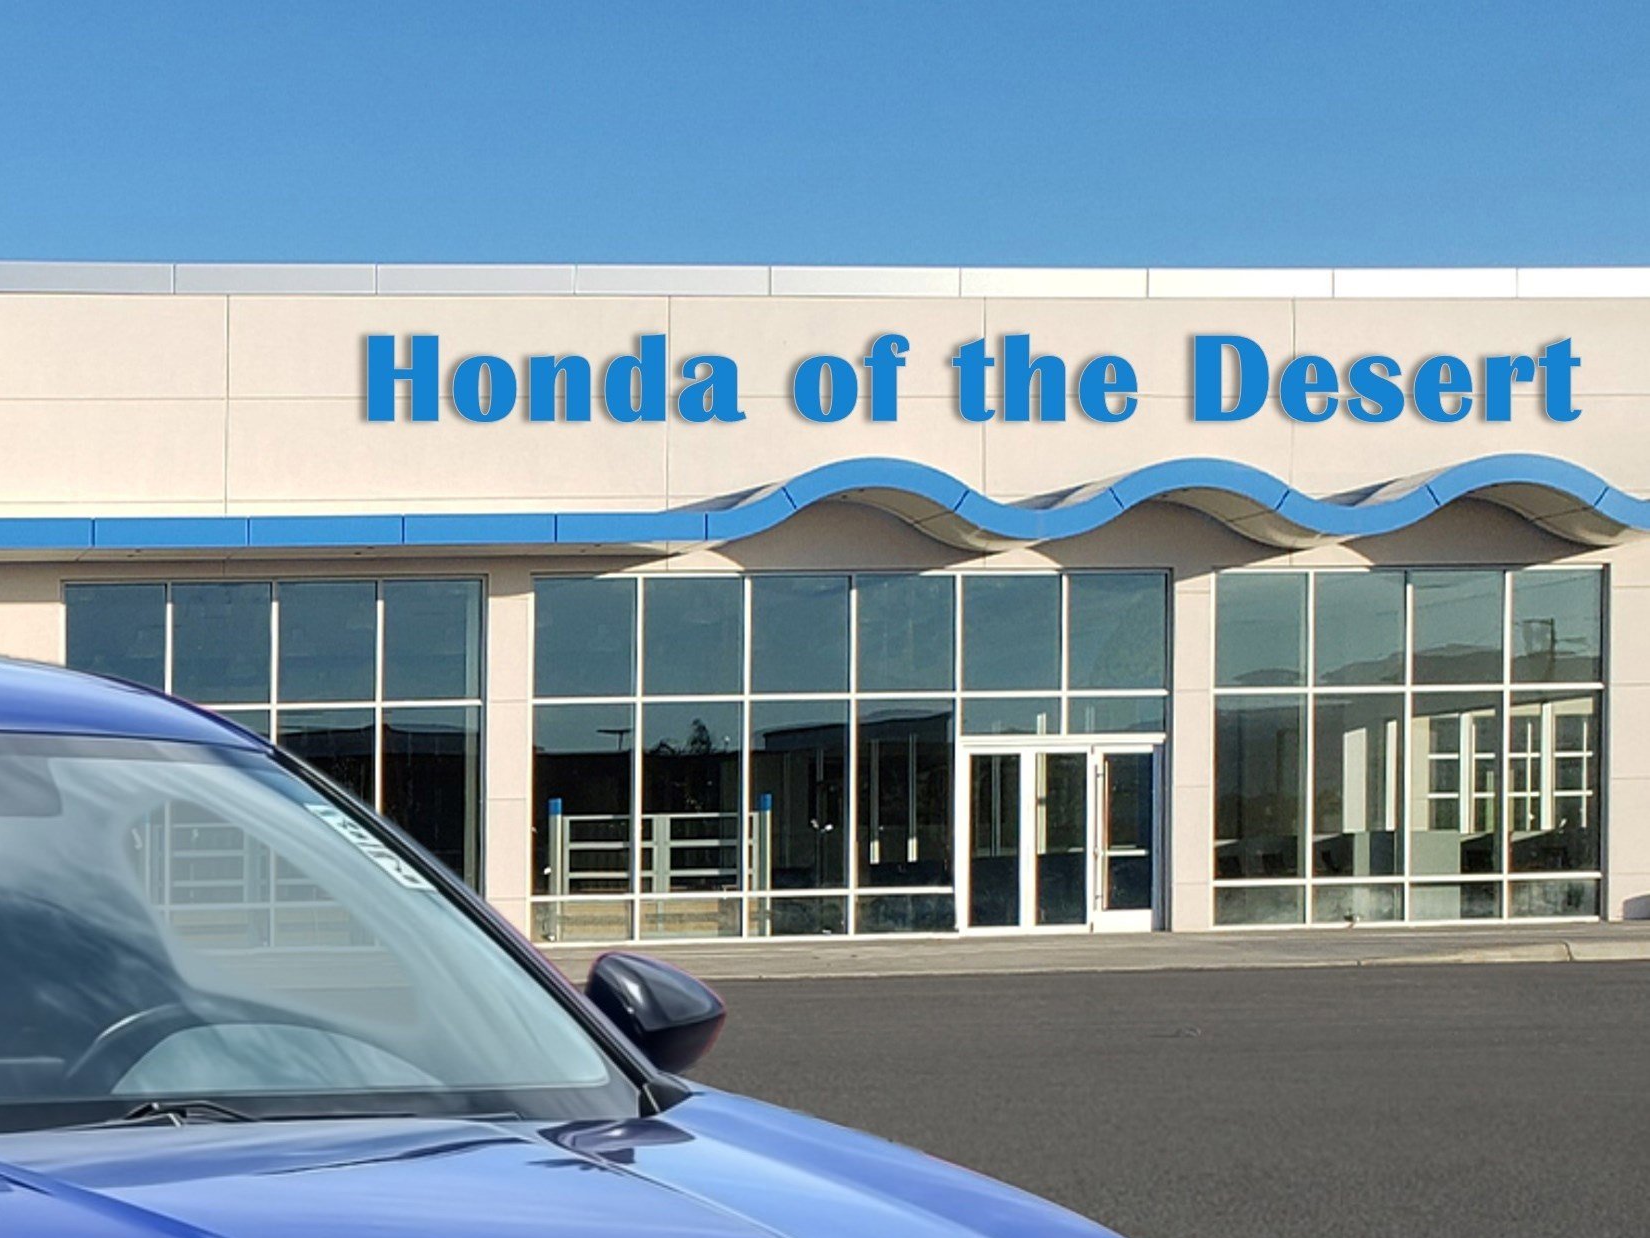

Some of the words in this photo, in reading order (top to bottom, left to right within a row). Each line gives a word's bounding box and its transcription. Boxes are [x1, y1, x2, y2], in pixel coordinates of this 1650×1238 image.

[366, 333, 747, 424] Honda
[793, 333, 911, 424] of
[951, 333, 1139, 424] the
[1193, 334, 1583, 424] Desert
